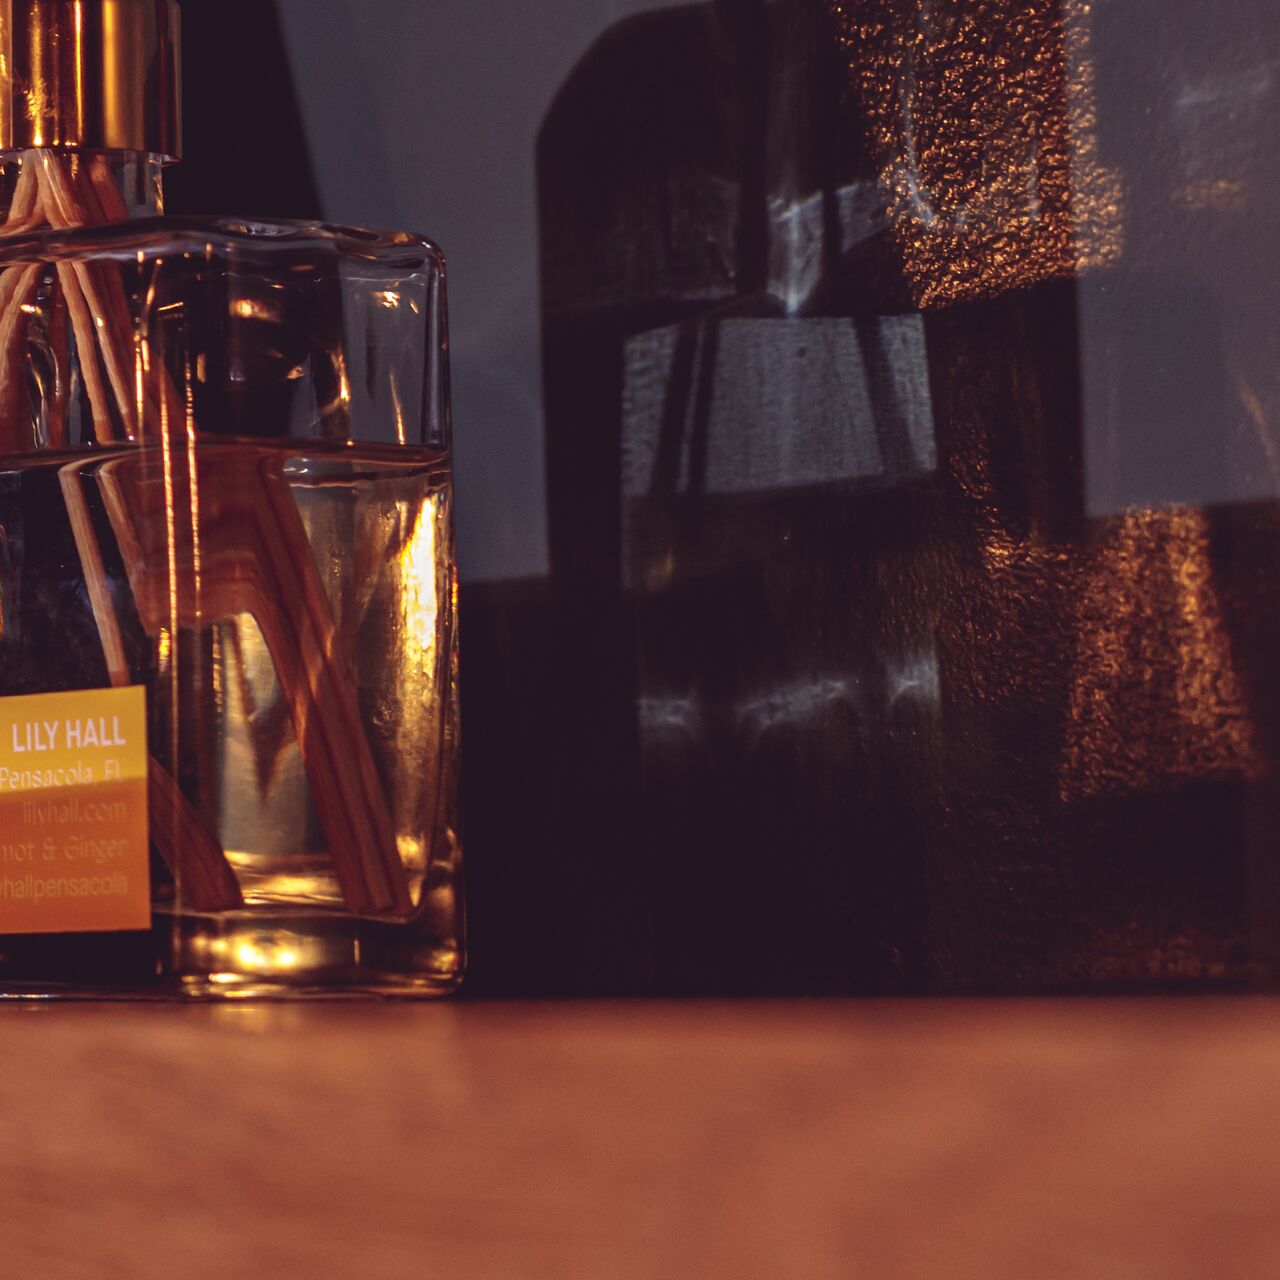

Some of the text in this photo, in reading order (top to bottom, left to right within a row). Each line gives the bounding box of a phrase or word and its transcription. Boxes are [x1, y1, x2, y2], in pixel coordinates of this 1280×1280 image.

[11, 715, 127, 752] LILY HALL
[63, 834, 129, 864] Ginger
